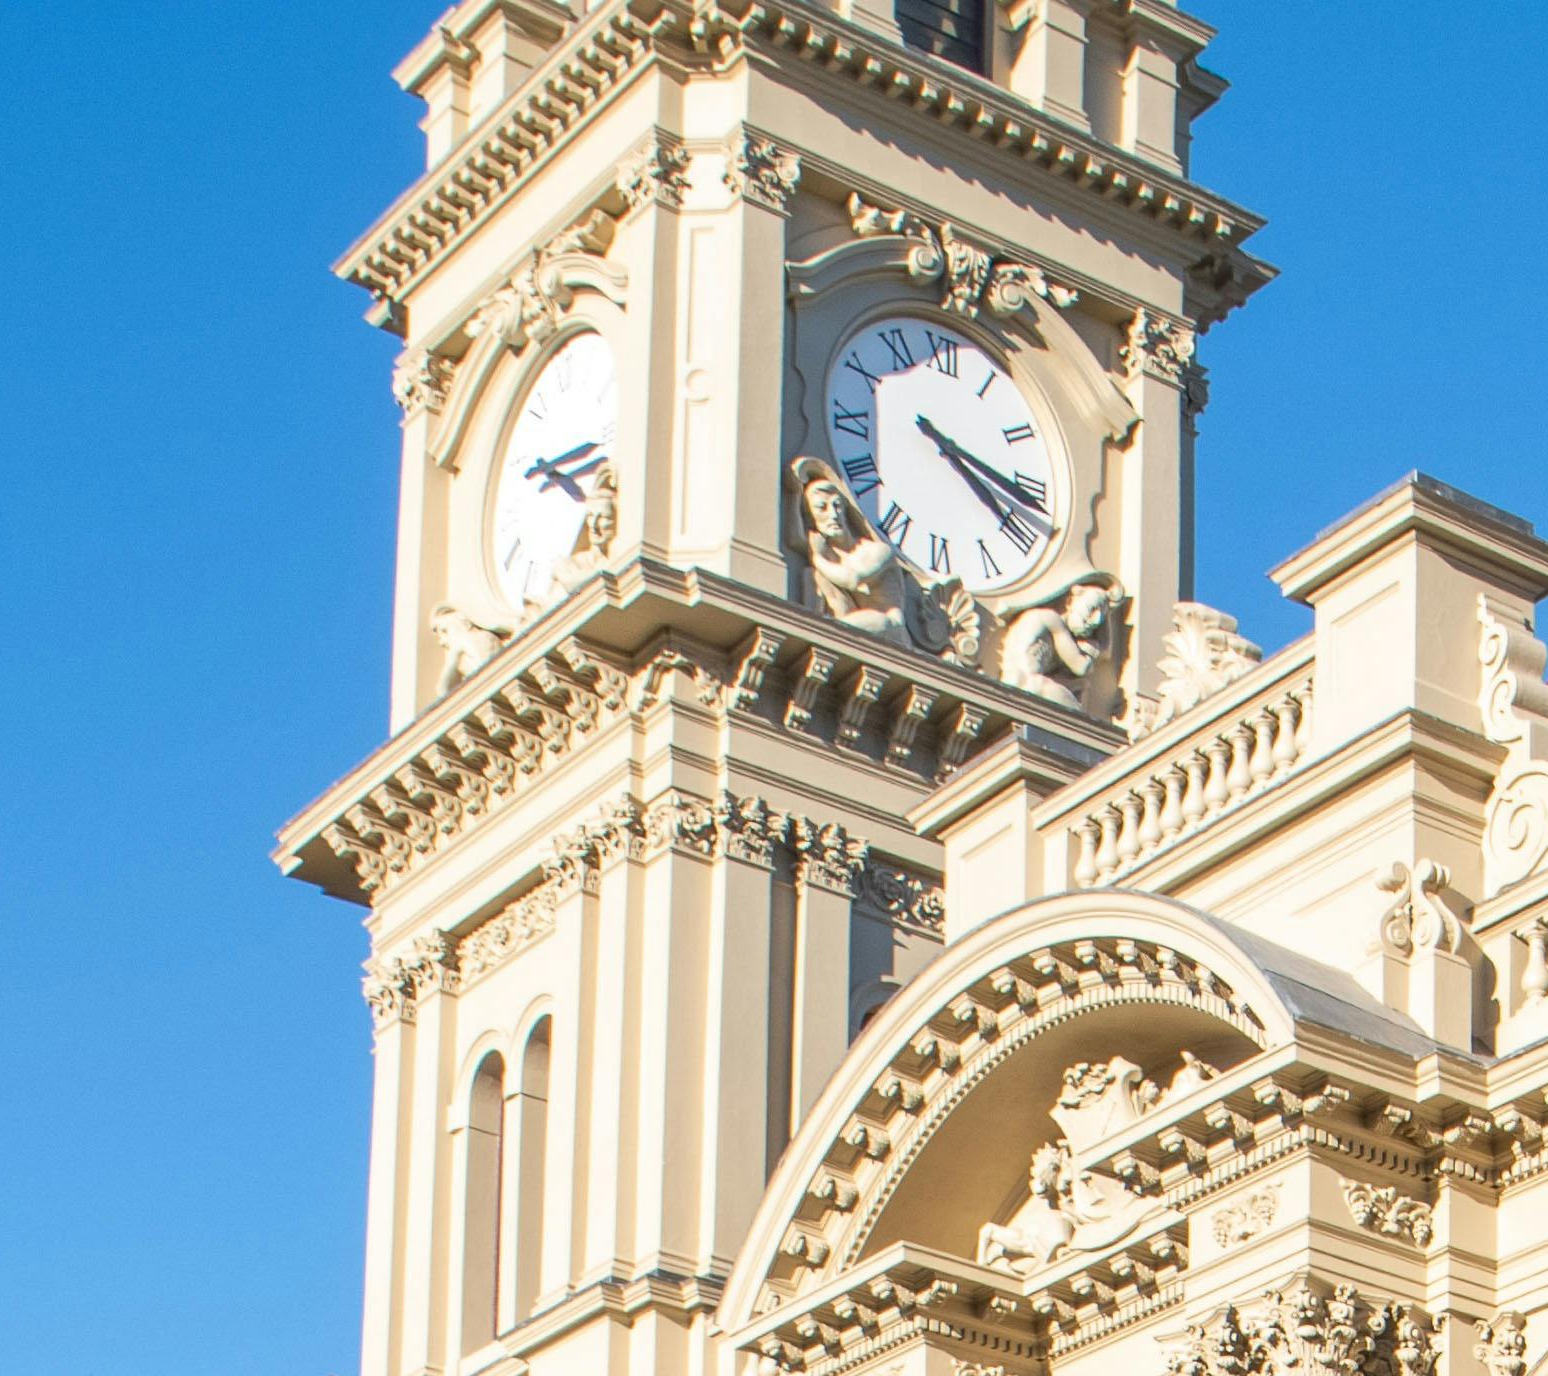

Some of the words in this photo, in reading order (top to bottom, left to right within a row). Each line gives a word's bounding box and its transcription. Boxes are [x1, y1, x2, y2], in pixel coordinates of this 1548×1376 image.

[878, 328, 917, 371] XI
[925, 329, 960, 379] XII
[843, 351, 882, 394] X
[834, 399, 869, 441] IX
[1002, 422, 1035, 445] II
[842, 453, 884, 498] VIII
[878, 500, 912, 548] VII
[929, 533, 951, 574] VI
[976, 538, 1002, 580] V
